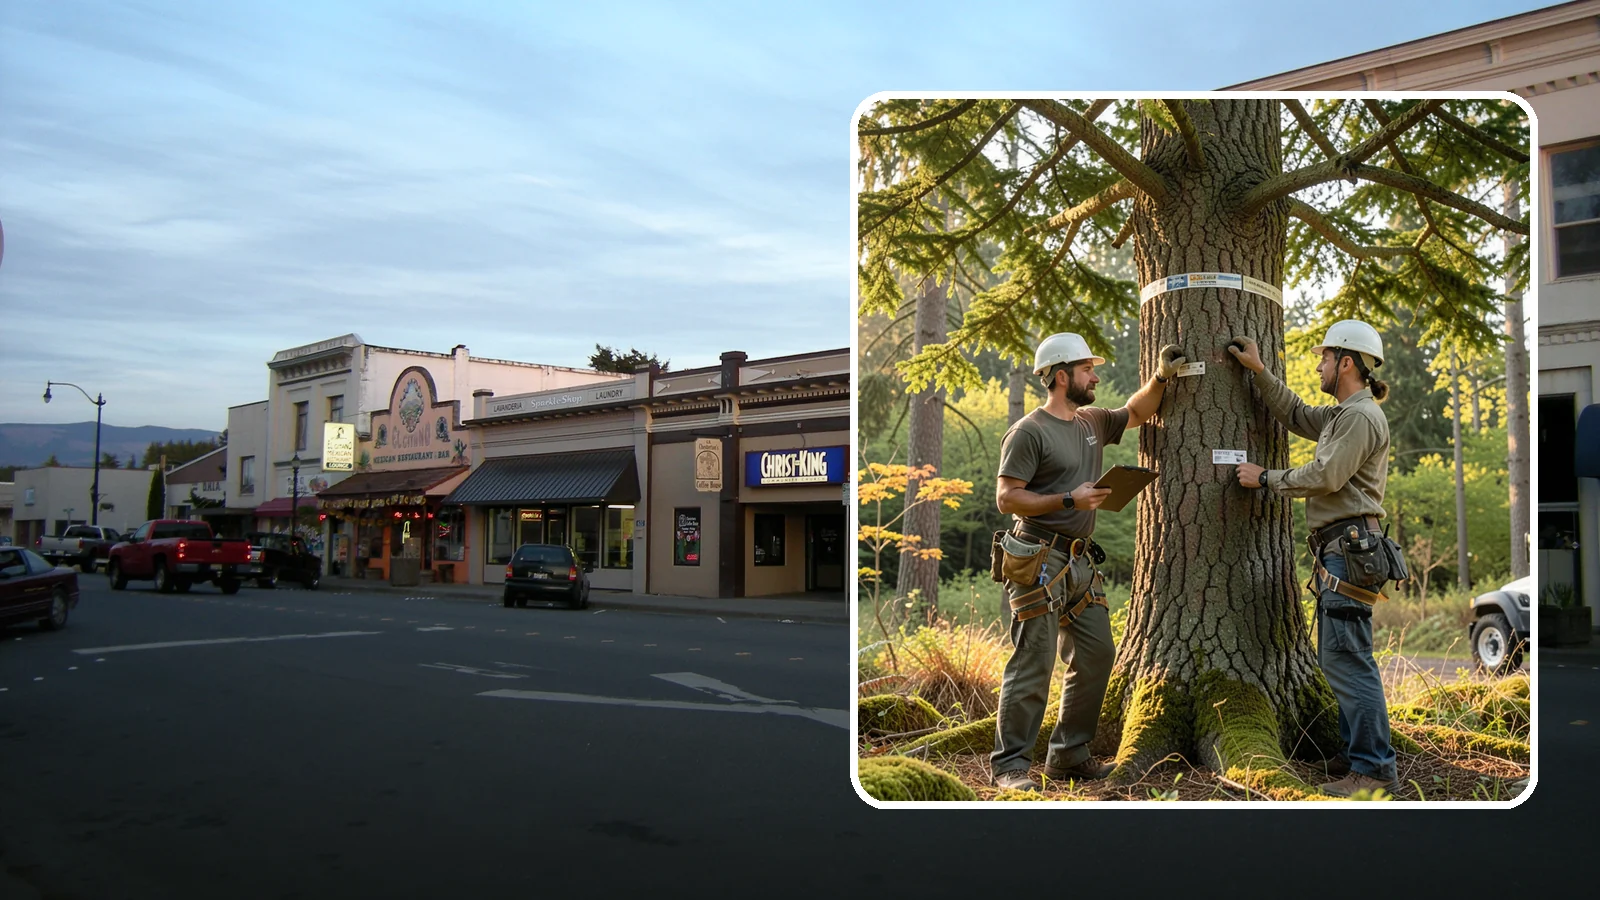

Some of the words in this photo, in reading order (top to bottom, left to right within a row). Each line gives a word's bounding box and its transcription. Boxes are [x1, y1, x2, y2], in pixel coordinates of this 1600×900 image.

[595, 389, 623, 399] LAUNDRY
[493, 402, 523, 413] LAVANDERIA
[530, 396, 560, 409] Sparkle
[561, 394, 583, 405] Shop
[373, 455, 396, 464] MEXICAN
[397, 452, 433, 463] RESTAURANT
[438, 450, 450, 459] BAR
[761, 452, 797, 478] CHRIST
[799, 449, 827, 476] KING
[696, 480, 709, 488] Coffee
